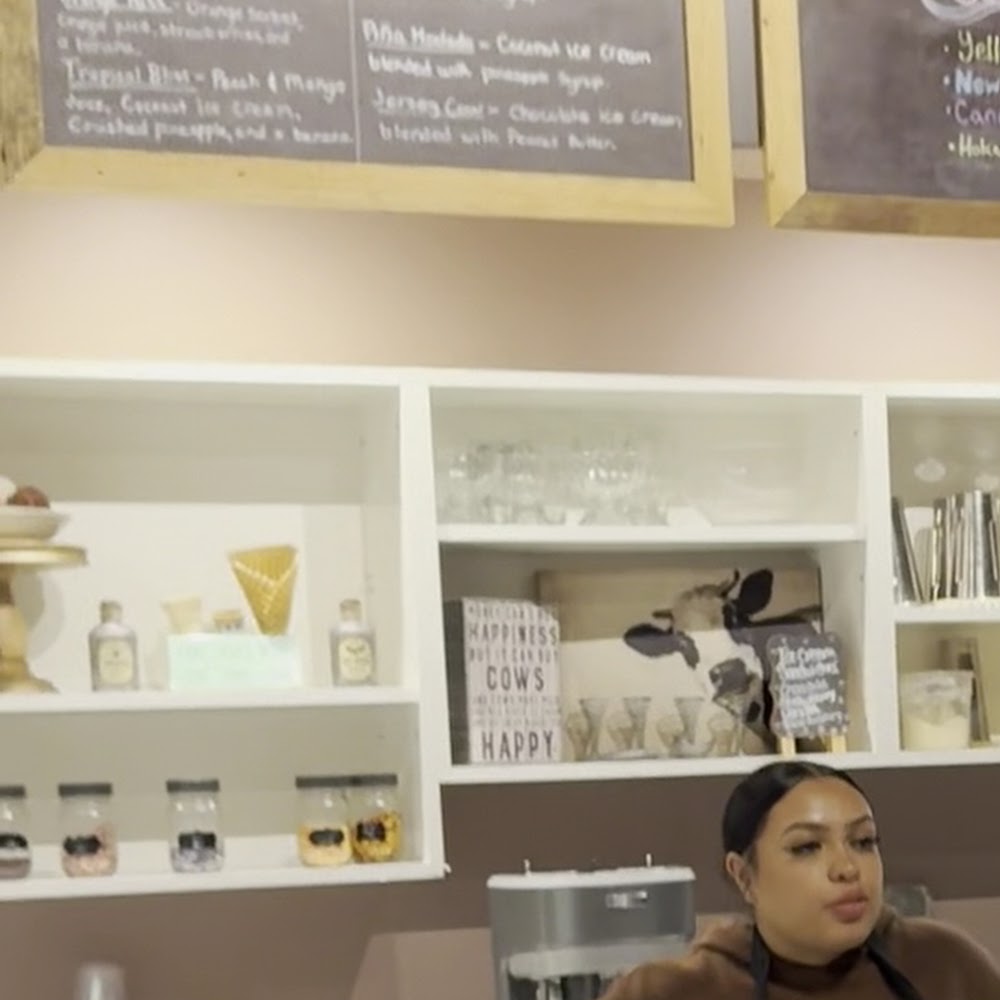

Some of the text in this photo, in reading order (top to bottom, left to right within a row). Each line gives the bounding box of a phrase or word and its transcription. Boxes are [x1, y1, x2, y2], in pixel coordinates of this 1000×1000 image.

[955, 69, 999, 95] New
[469, 623, 558, 646] HAPPINESS
[486, 666, 545, 692] COWS
[481, 729, 553, 761] HAPPY
